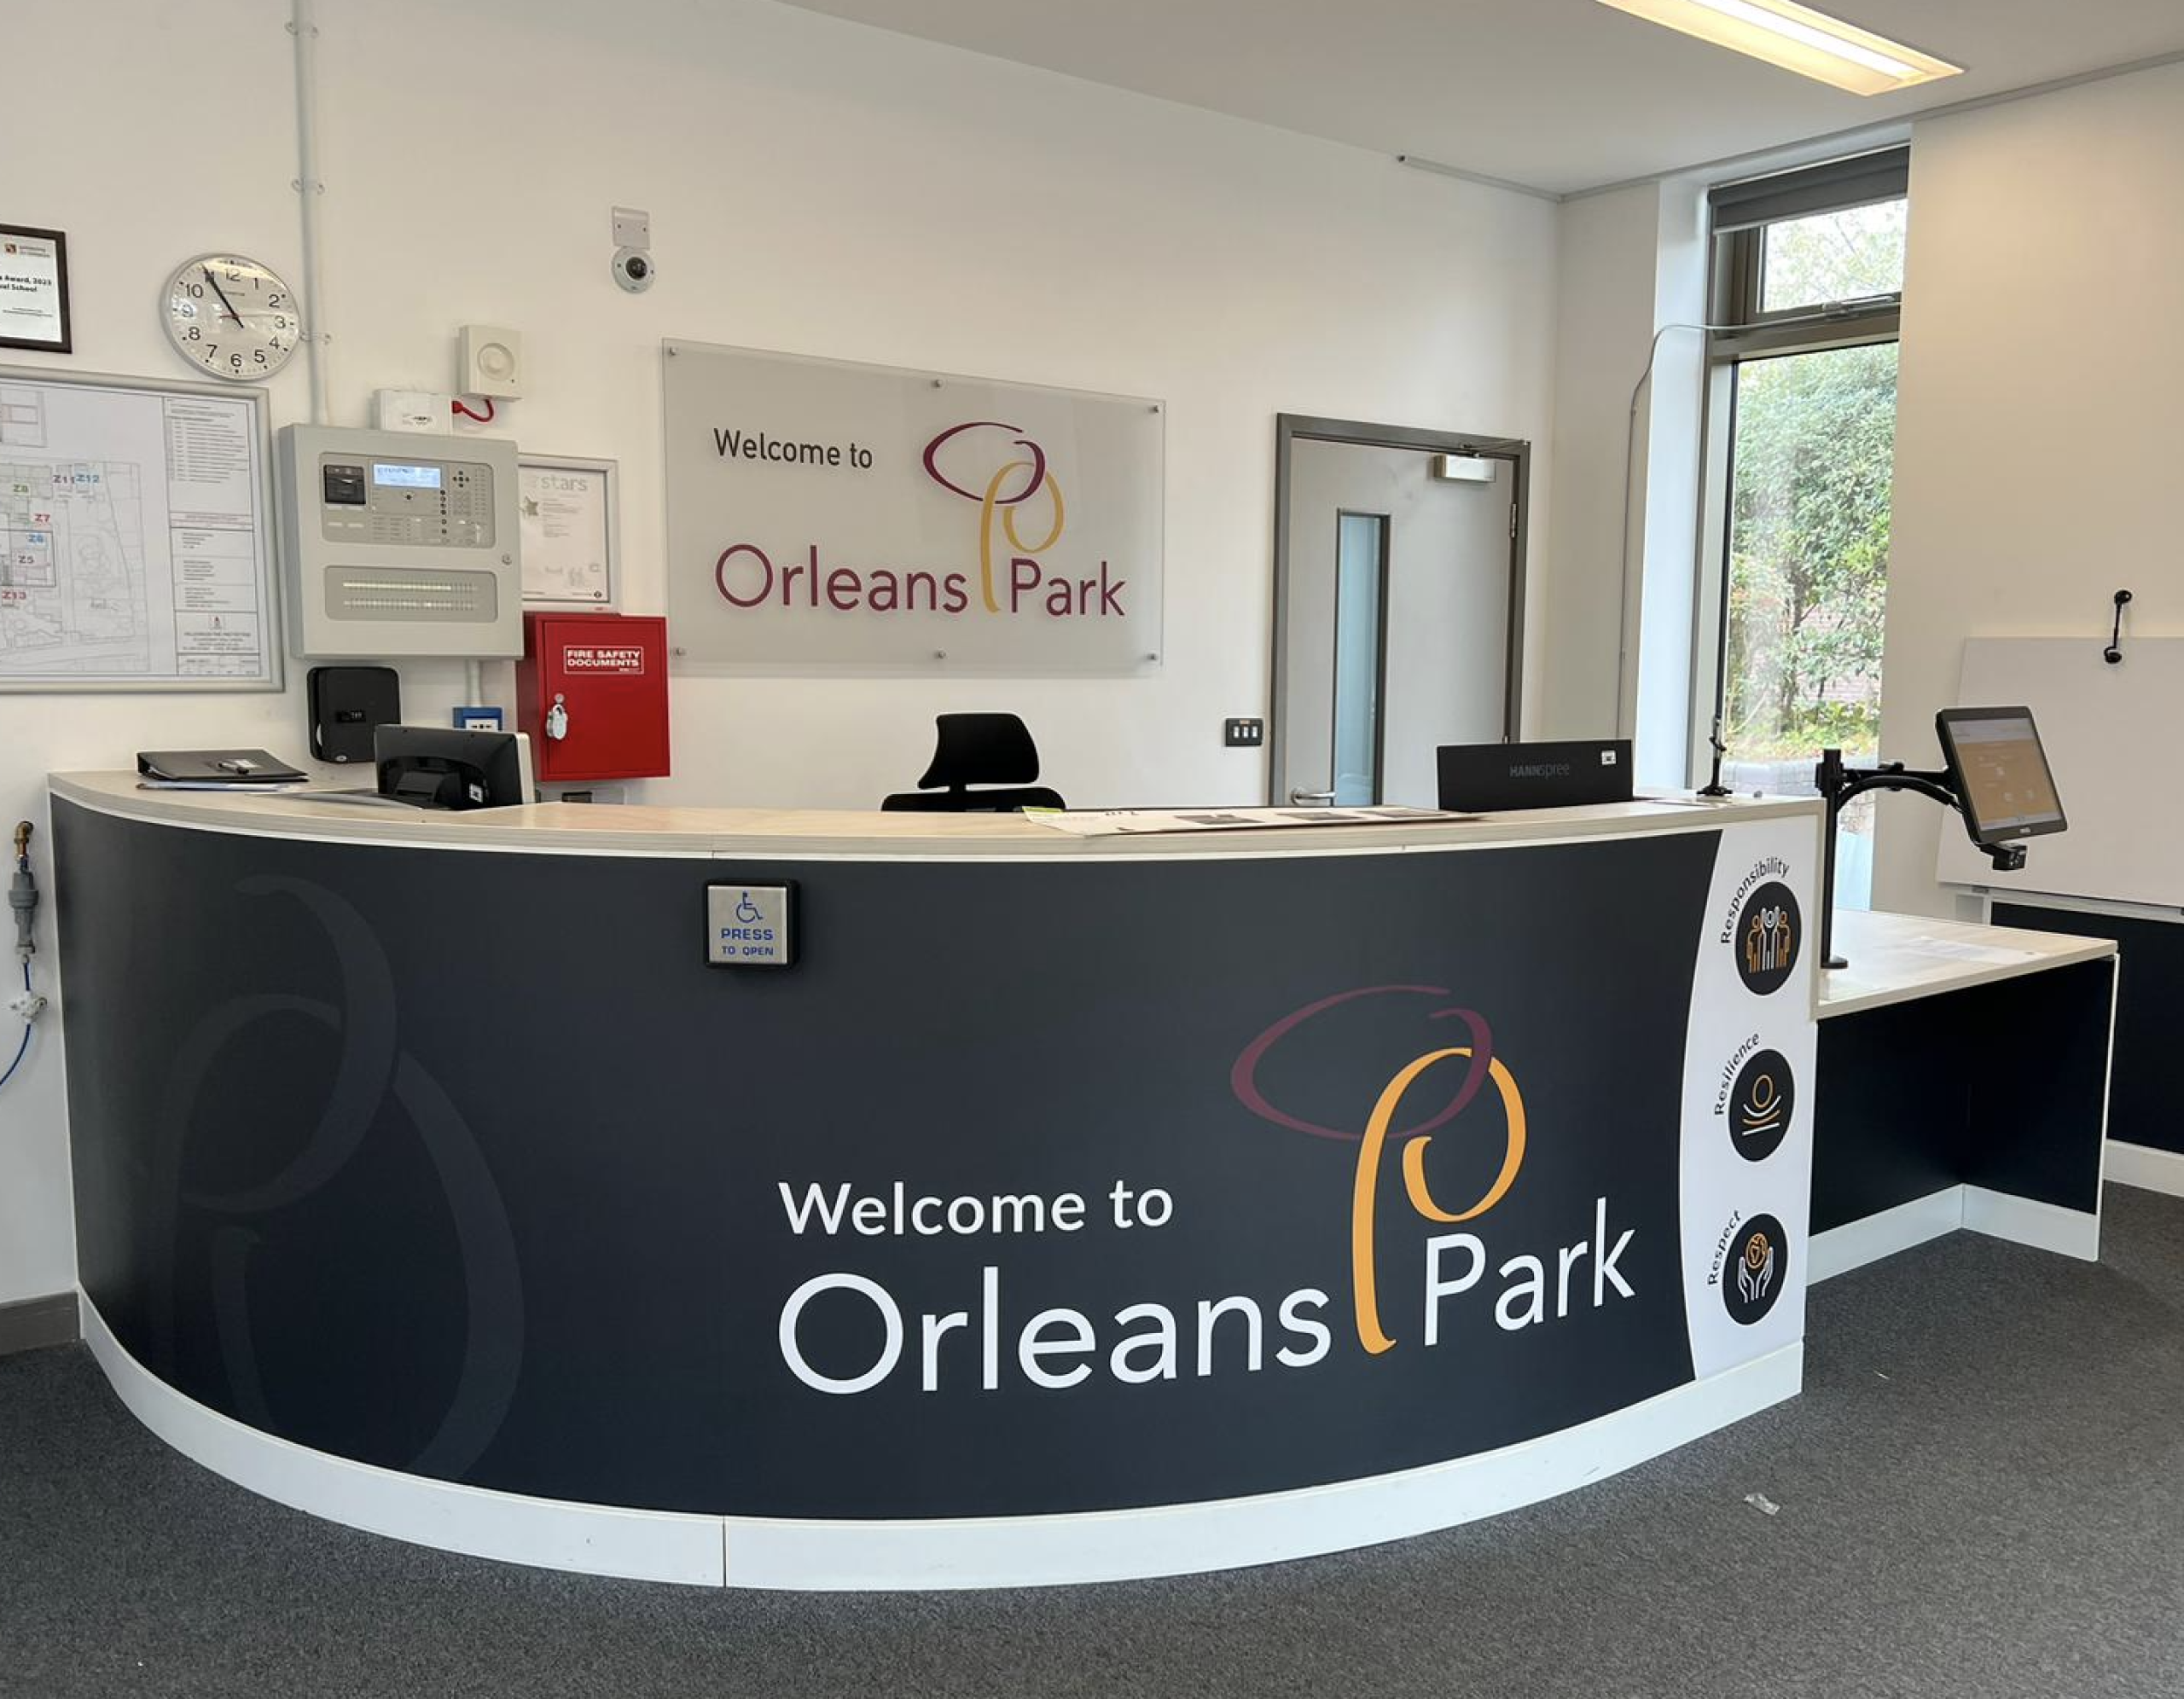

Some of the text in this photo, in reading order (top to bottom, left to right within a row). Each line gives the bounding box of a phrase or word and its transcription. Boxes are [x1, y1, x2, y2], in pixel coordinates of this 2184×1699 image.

[225, 269, 241, 281] 12
[253, 277, 259, 290] 1
[186, 284, 204, 299] 10
[268, 294, 281, 308] 2
[182, 304, 194, 318] 9
[275, 315, 287, 329] 3
[188, 326, 201, 340] 8
[269, 336, 280, 350] 4
[206, 344, 218, 359] 7
[254, 349, 265, 363] 5
[230, 353, 242, 367] 6
[713, 427, 874, 469] Welcome to
[715, 543, 1127, 618] Orleans Park
[567, 650, 641, 658] FIRE SAFETY
[1720, 857, 1790, 944] Responsibility
[720, 928, 774, 941] PRESS
[721, 945, 774, 956] TO OPEN
[1714, 1033, 1760, 1116] Resilience
[778, 1180, 1174, 1236] Welcome to
[1707, 1209, 1741, 1285] Respect
[778, 1196, 1635, 1395] Orleans Park
